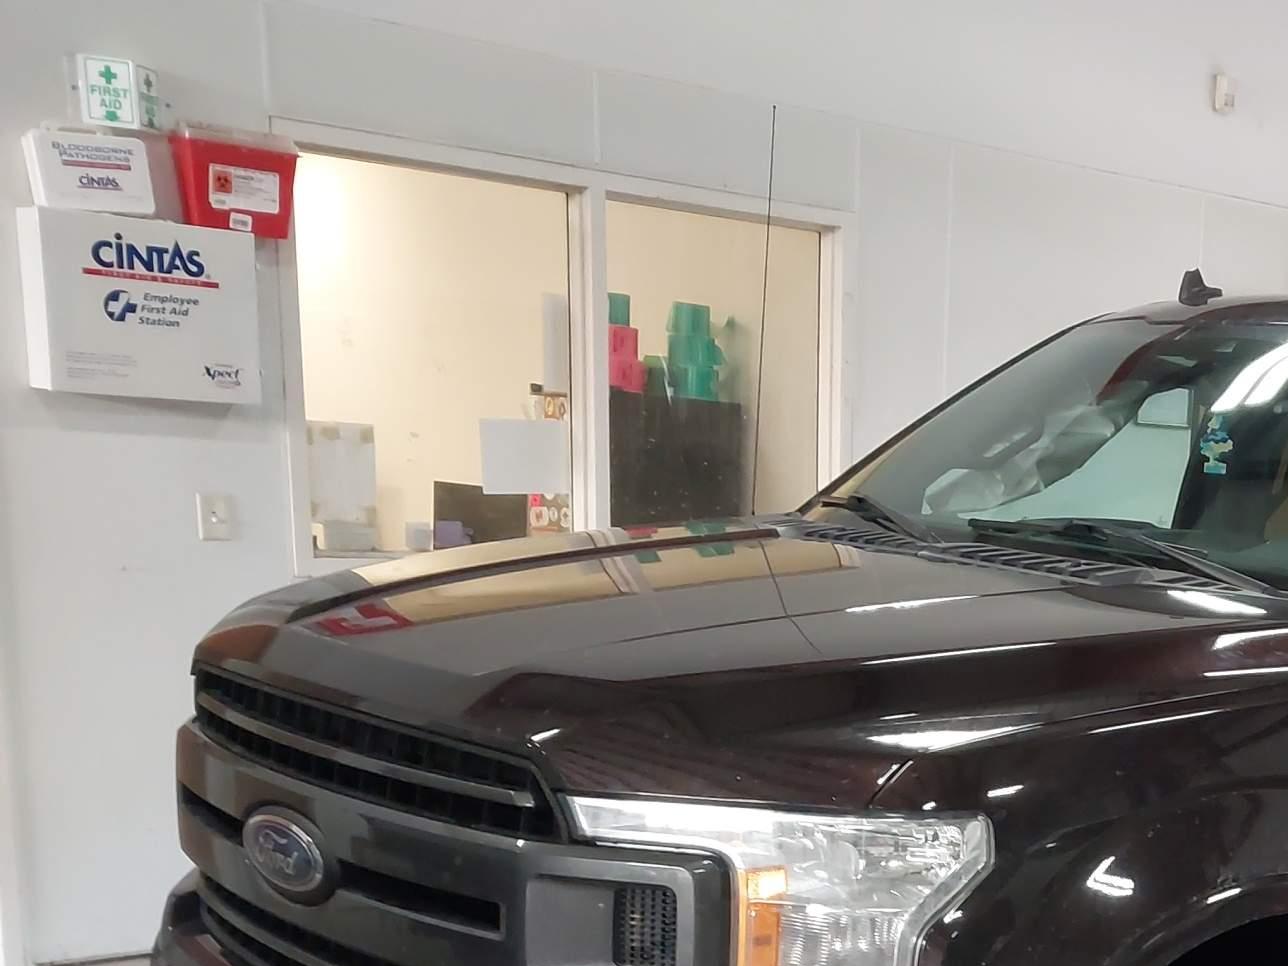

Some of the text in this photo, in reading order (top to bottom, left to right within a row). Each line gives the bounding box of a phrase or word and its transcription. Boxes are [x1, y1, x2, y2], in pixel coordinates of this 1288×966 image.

[89, 84, 129, 99] FIRST
[100, 98, 122, 110] AID
[143, 292, 200, 306] Employee
[140, 304, 189, 316] First Aid
[138, 316, 180, 328] Station
